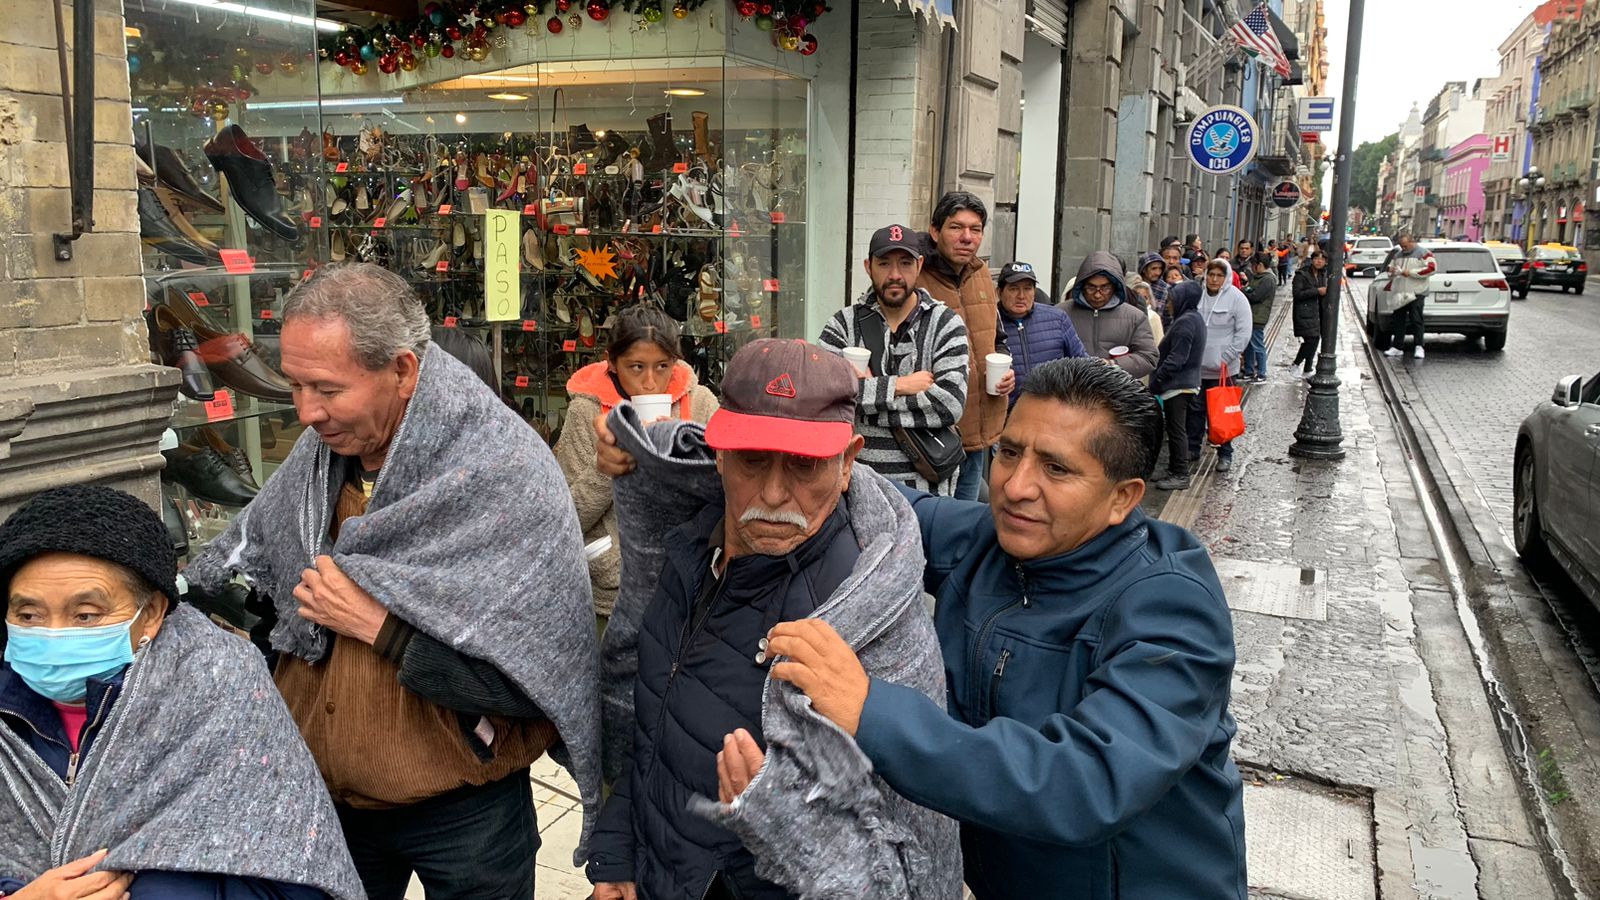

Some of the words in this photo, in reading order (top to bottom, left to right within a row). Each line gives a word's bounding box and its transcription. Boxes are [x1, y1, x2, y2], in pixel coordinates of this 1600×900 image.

[1191, 111, 1251, 145] COMPUINGLES
[1494, 136, 1510, 153] H
[1209, 157, 1231, 169] ICO
[1416, 187, 1424, 196] H
[889, 225, 903, 241] B
[492, 215, 510, 316] PASO
